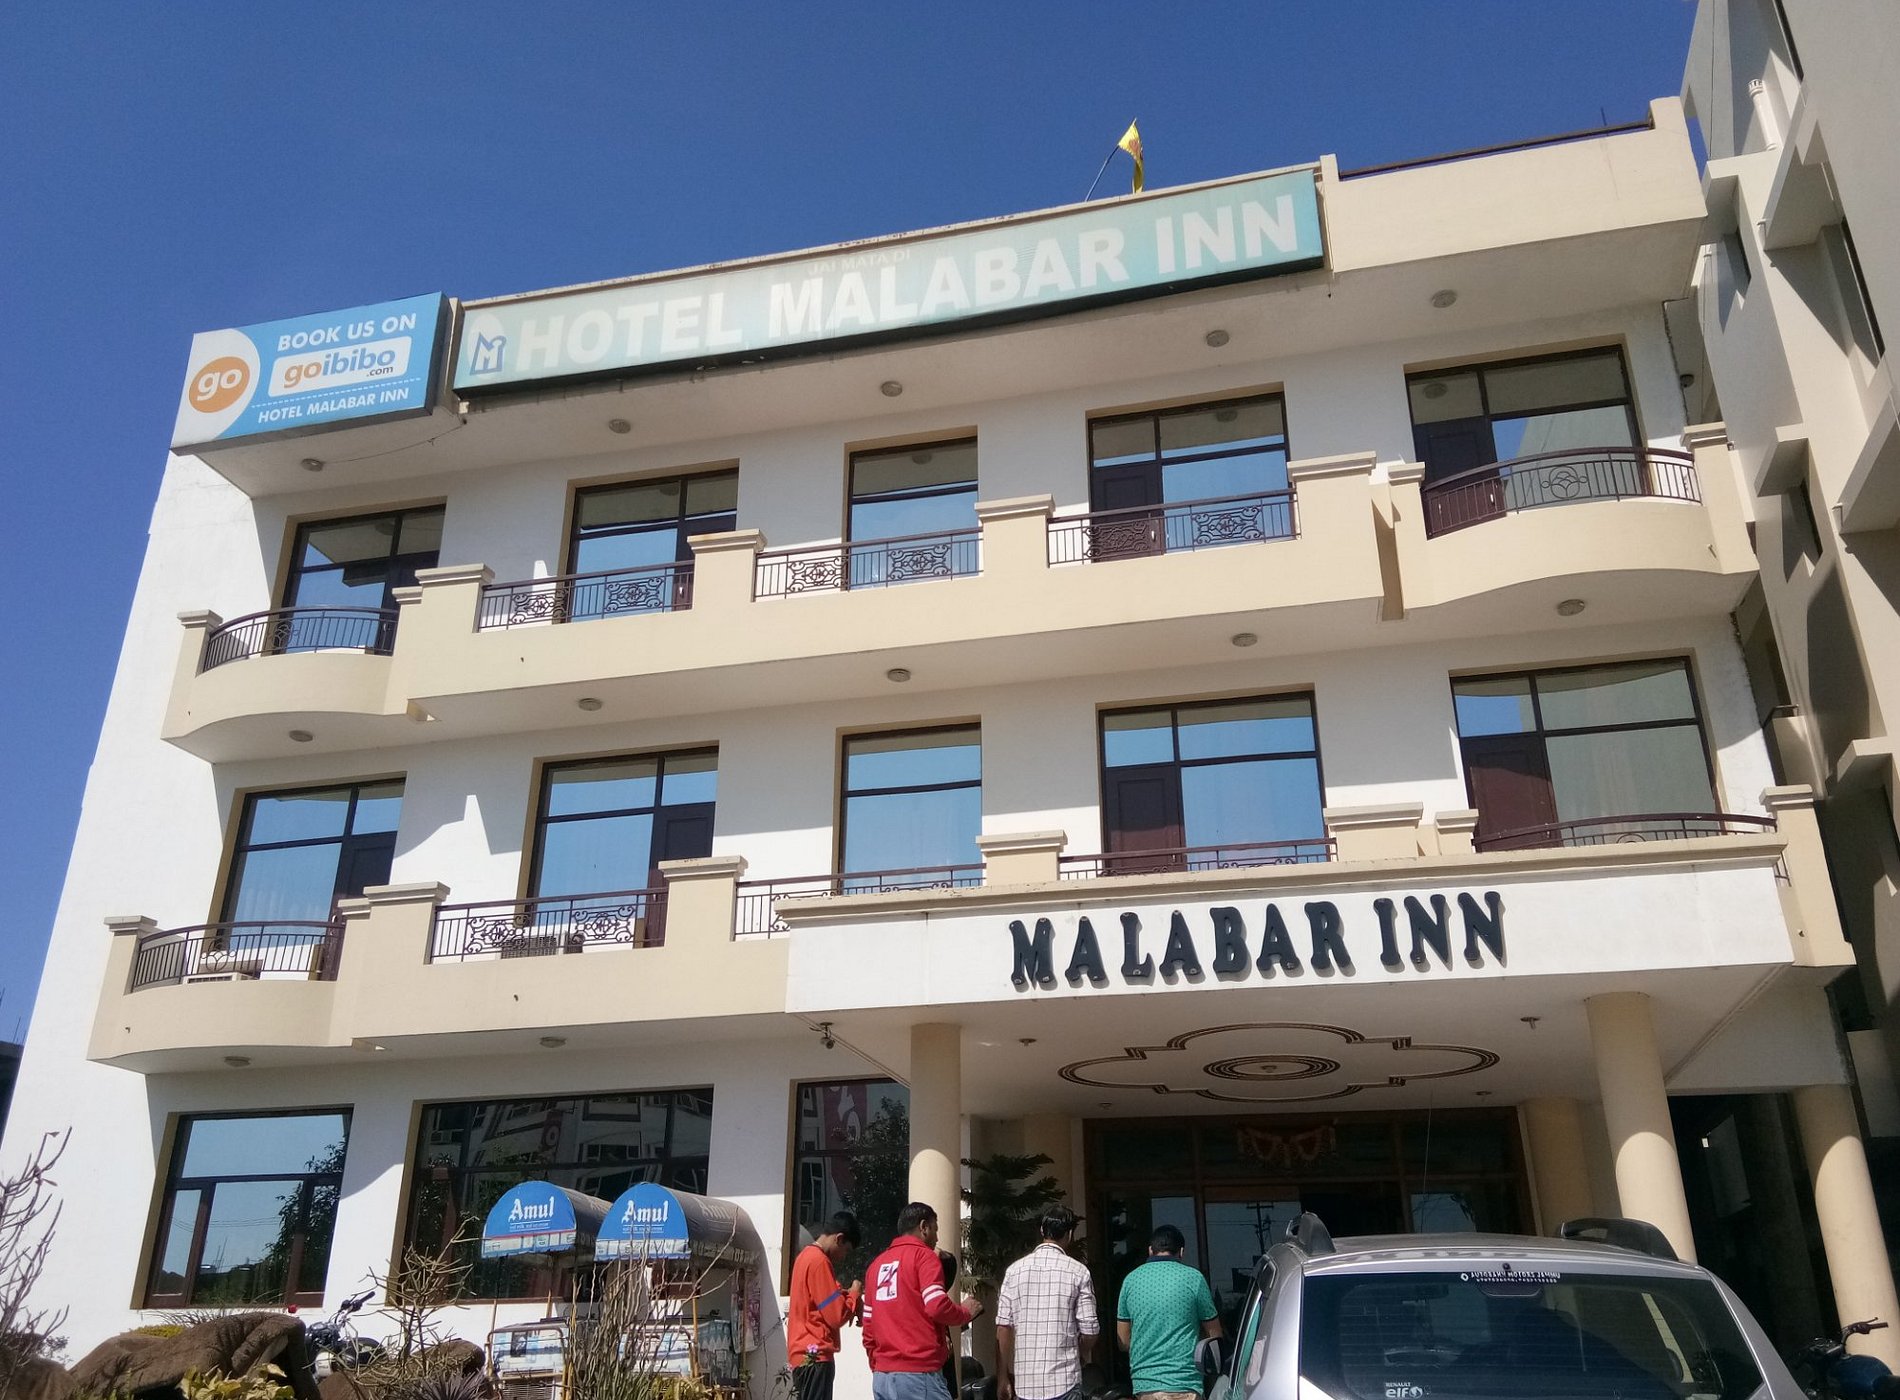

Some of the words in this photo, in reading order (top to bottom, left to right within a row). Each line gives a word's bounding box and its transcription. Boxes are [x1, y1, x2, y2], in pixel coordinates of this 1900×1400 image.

[515, 291, 743, 374] HOTEL
[768, 227, 1130, 340] MALABAR
[1155, 194, 1298, 275] INN
[277, 326, 340, 352] BOOK
[347, 319, 374, 340] US
[381, 312, 417, 334] ON
[196, 367, 242, 401] go
[283, 347, 396, 389] goibibo
[366, 364, 394, 378] .com
[258, 406, 303, 424] HOTEL
[306, 394, 375, 416] MALABAR
[379, 387, 409, 404] INN
[1009, 901, 1353, 986] MALABAR
[1373, 890, 1506, 967] INN
[508, 1196, 555, 1222] Amul
[621, 1200, 669, 1223] Amul
[1385, 1387, 1409, 1398] elf
